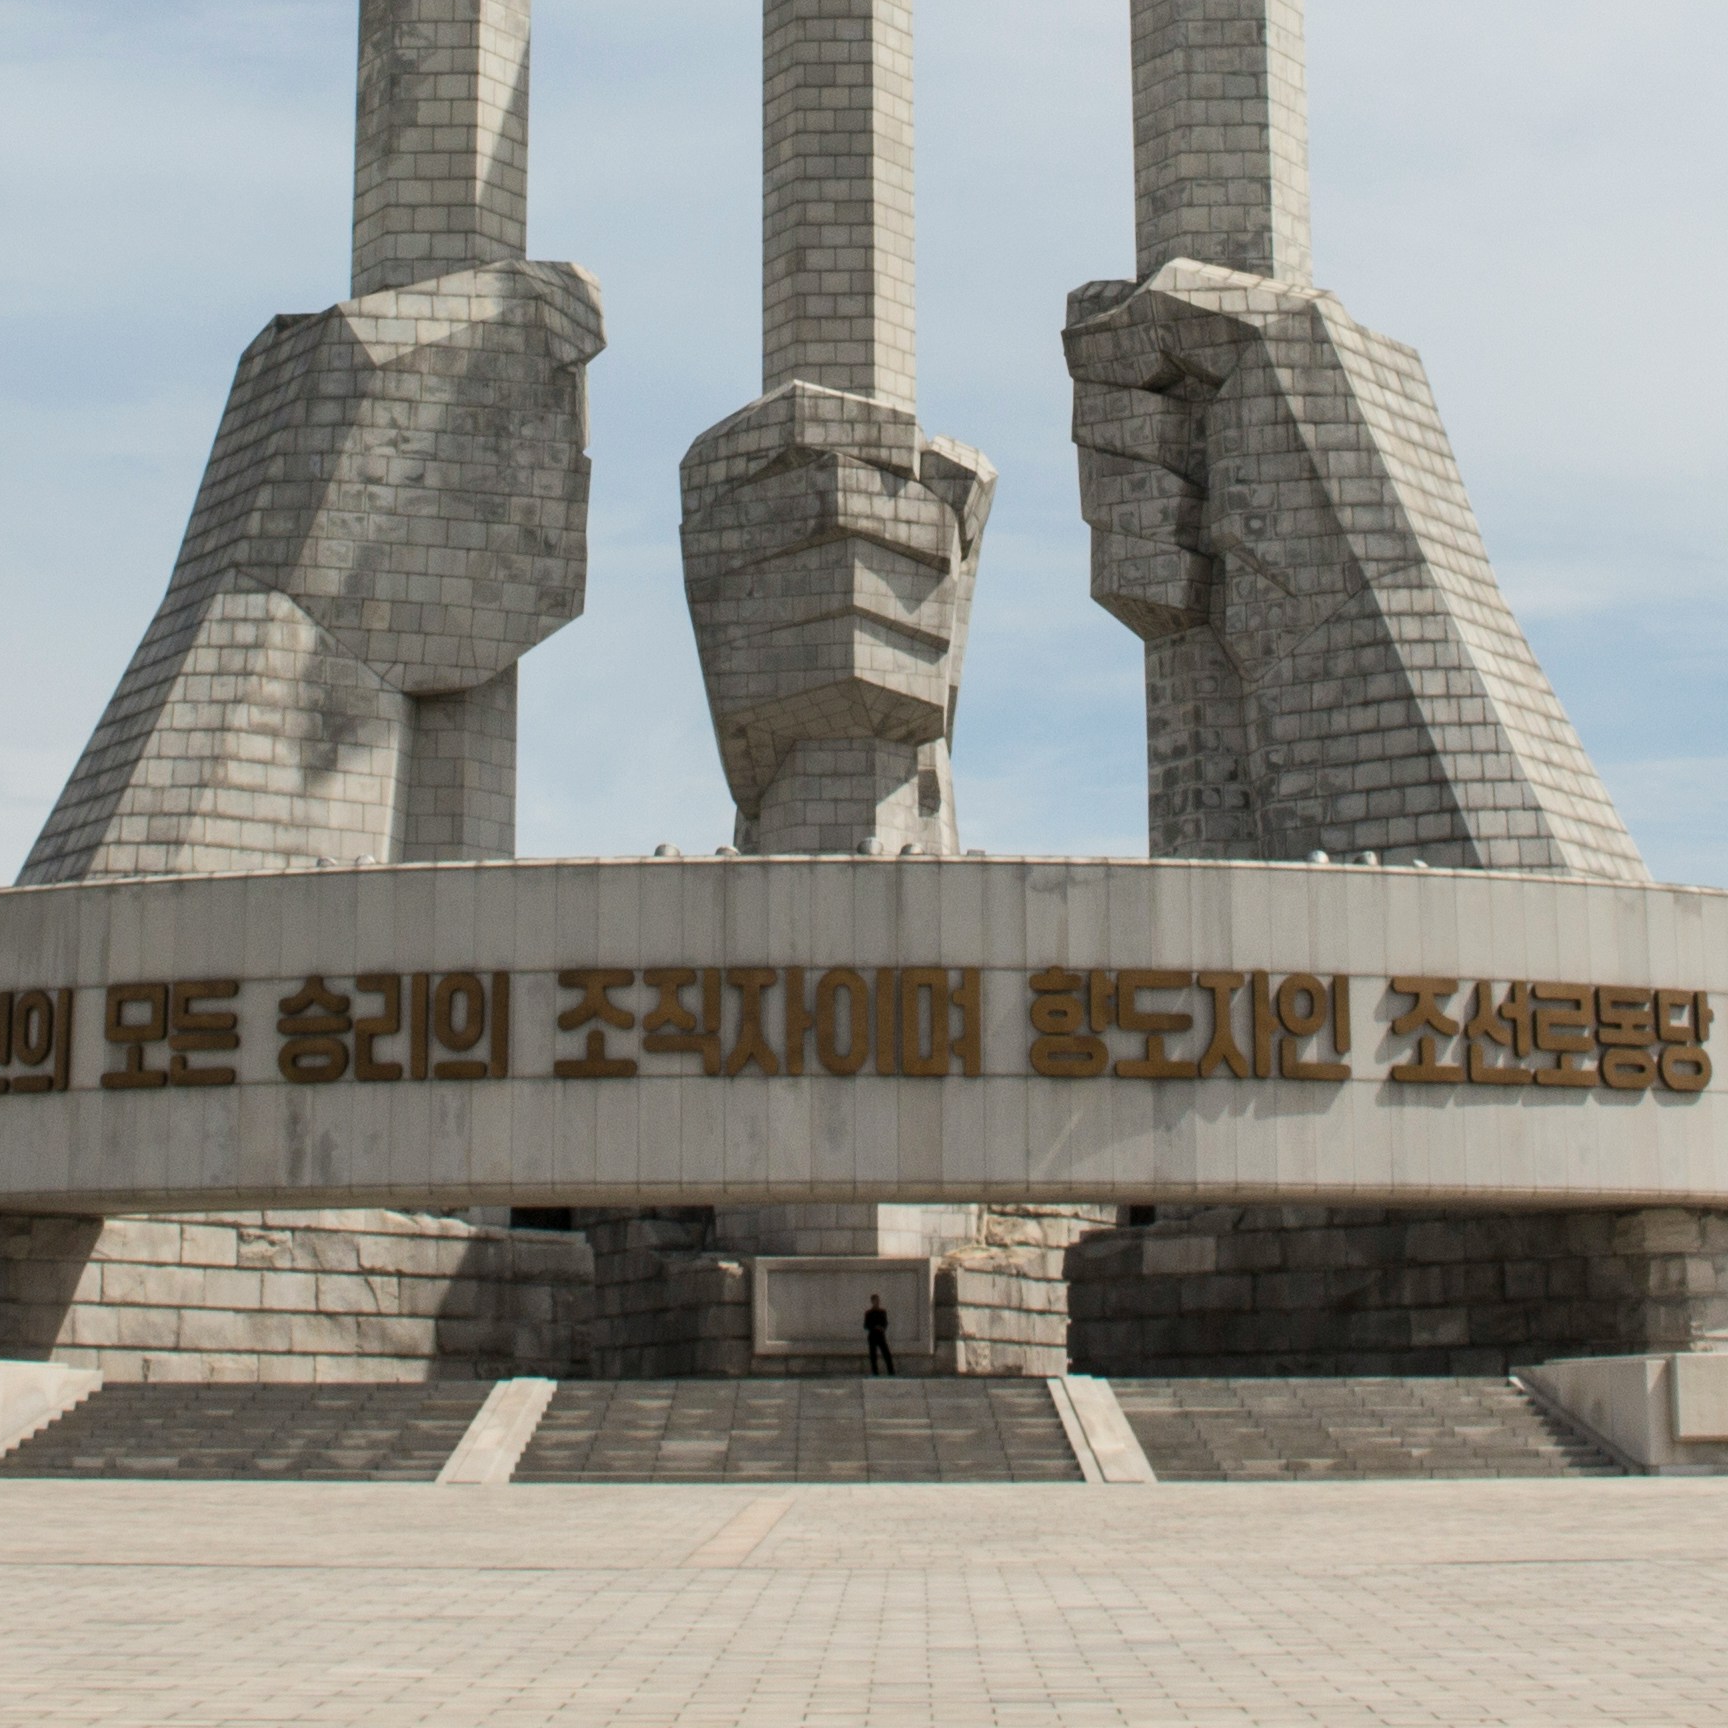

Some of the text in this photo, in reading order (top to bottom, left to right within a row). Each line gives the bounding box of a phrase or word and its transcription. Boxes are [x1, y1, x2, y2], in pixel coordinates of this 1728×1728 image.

[101, 980, 240, 1088] 모든
[277, 971, 511, 1083] 승리의
[554, 968, 981, 1078] 조직자이며
[1029, 965, 1352, 1080] 향도자인
[1390, 976, 1714, 1092] 조선로동당
